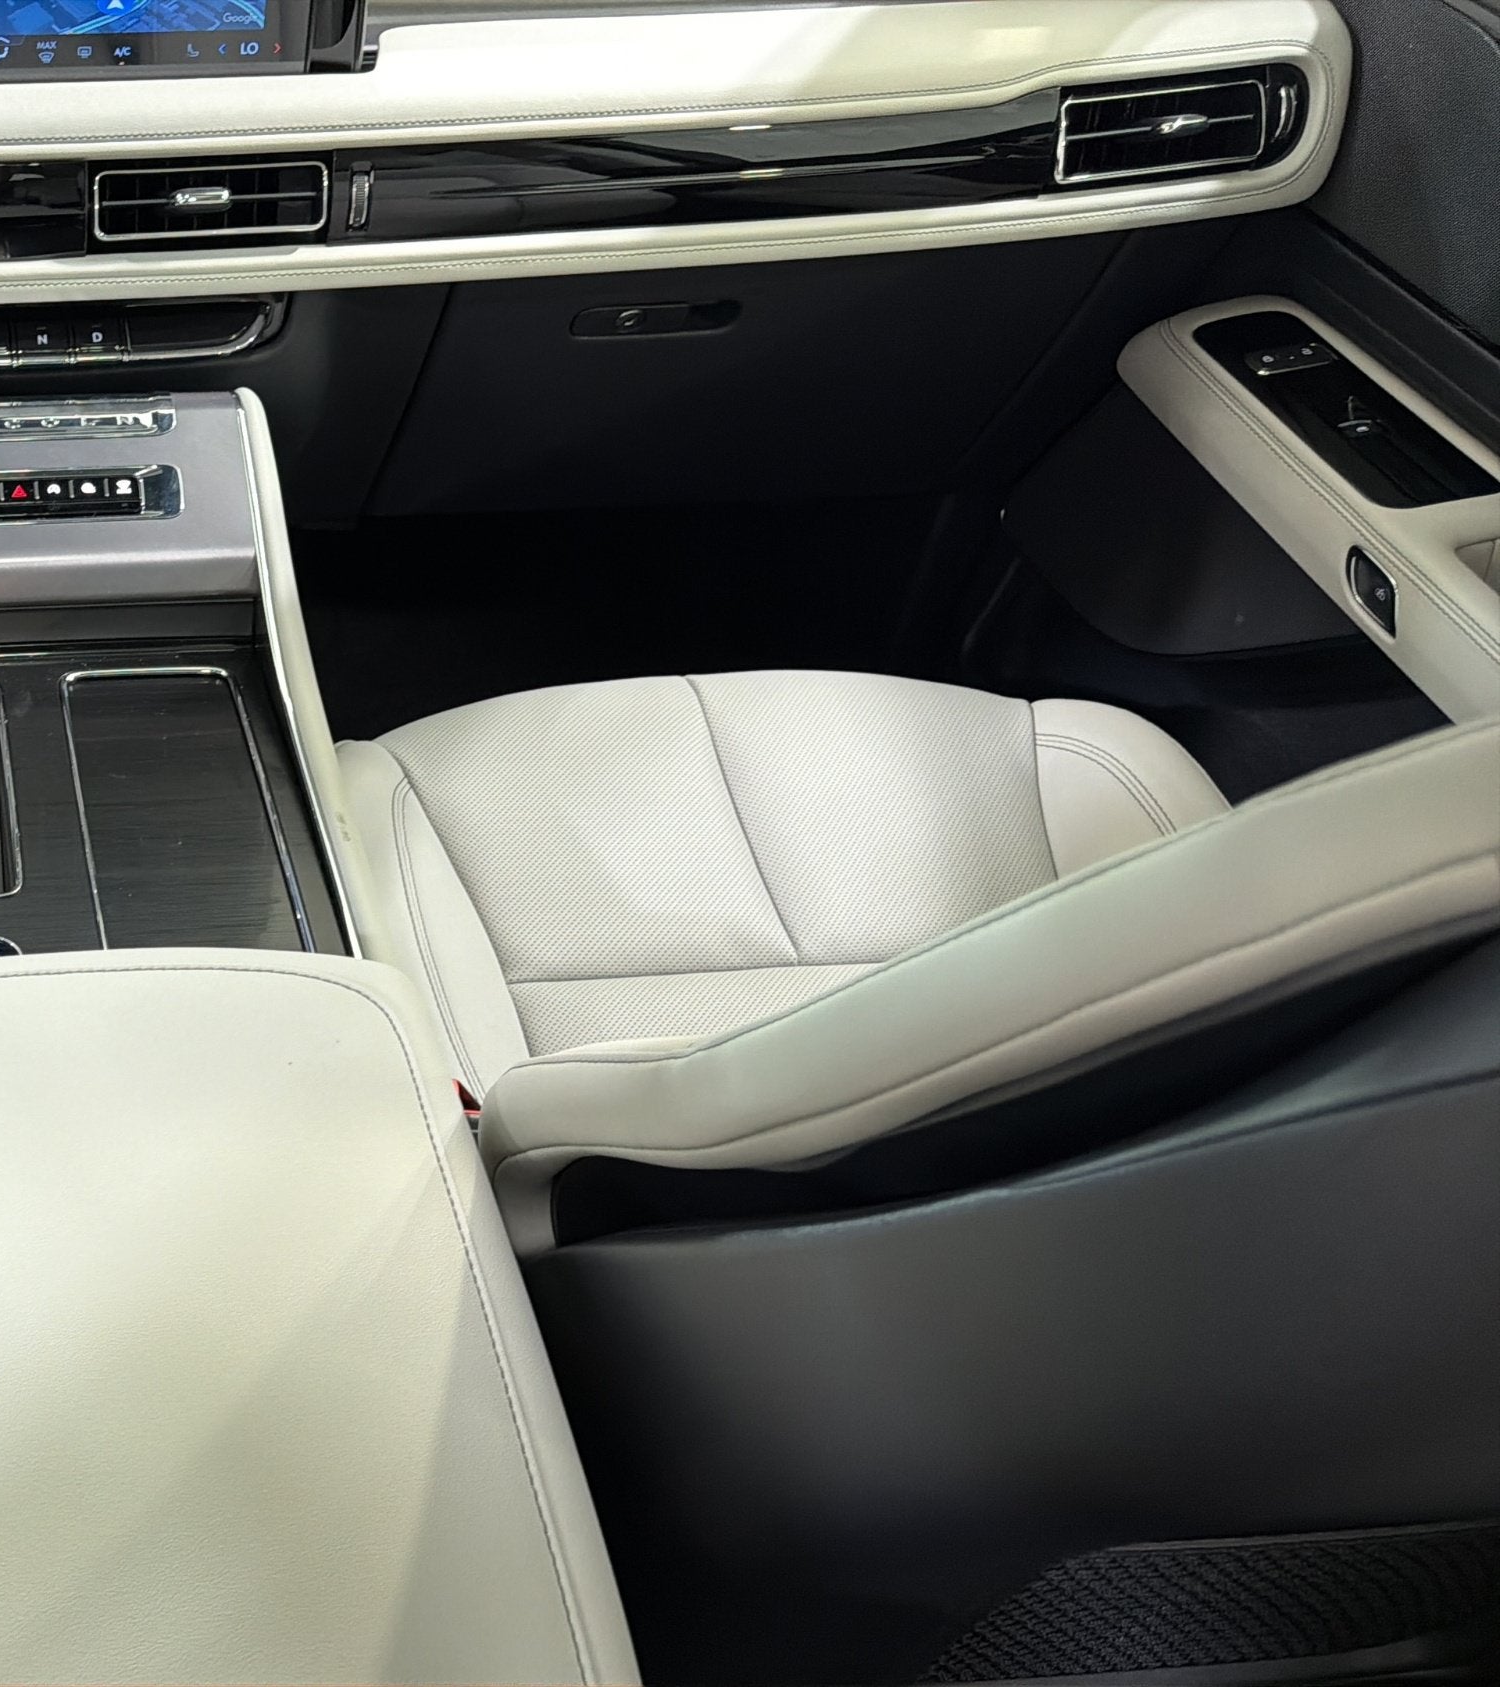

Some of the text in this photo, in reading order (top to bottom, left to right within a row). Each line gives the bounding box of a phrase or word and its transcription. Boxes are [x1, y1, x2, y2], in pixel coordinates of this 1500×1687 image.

[36, 41, 57, 50] MAX
[240, 42, 259, 55] LO
[113, 47, 131, 57] A/C
[36, 333, 49, 346] N
[91, 331, 103, 343] D
